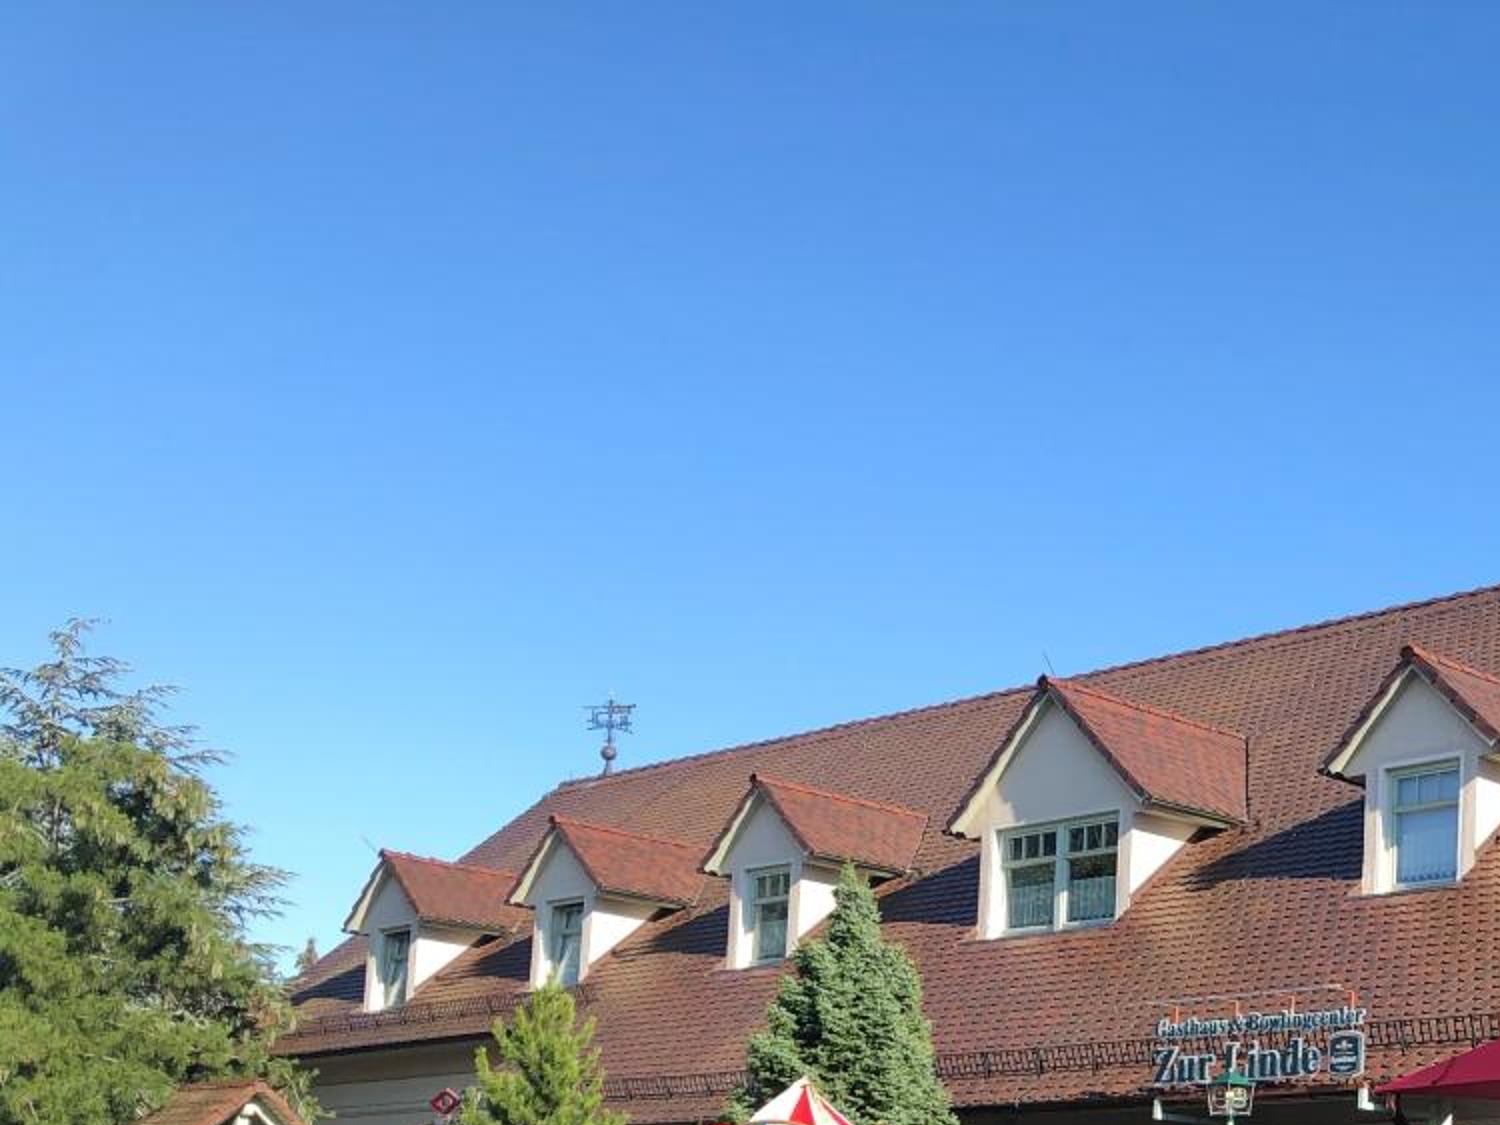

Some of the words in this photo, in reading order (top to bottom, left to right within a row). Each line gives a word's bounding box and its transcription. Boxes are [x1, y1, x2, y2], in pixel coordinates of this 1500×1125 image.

[1156, 1018, 1227, 1037] Gasthaus
[1247, 1006, 1366, 1031] Bowlingcenter
[1153, 1047, 1217, 1085] Zur
[1224, 1038, 1321, 1081] Linde
